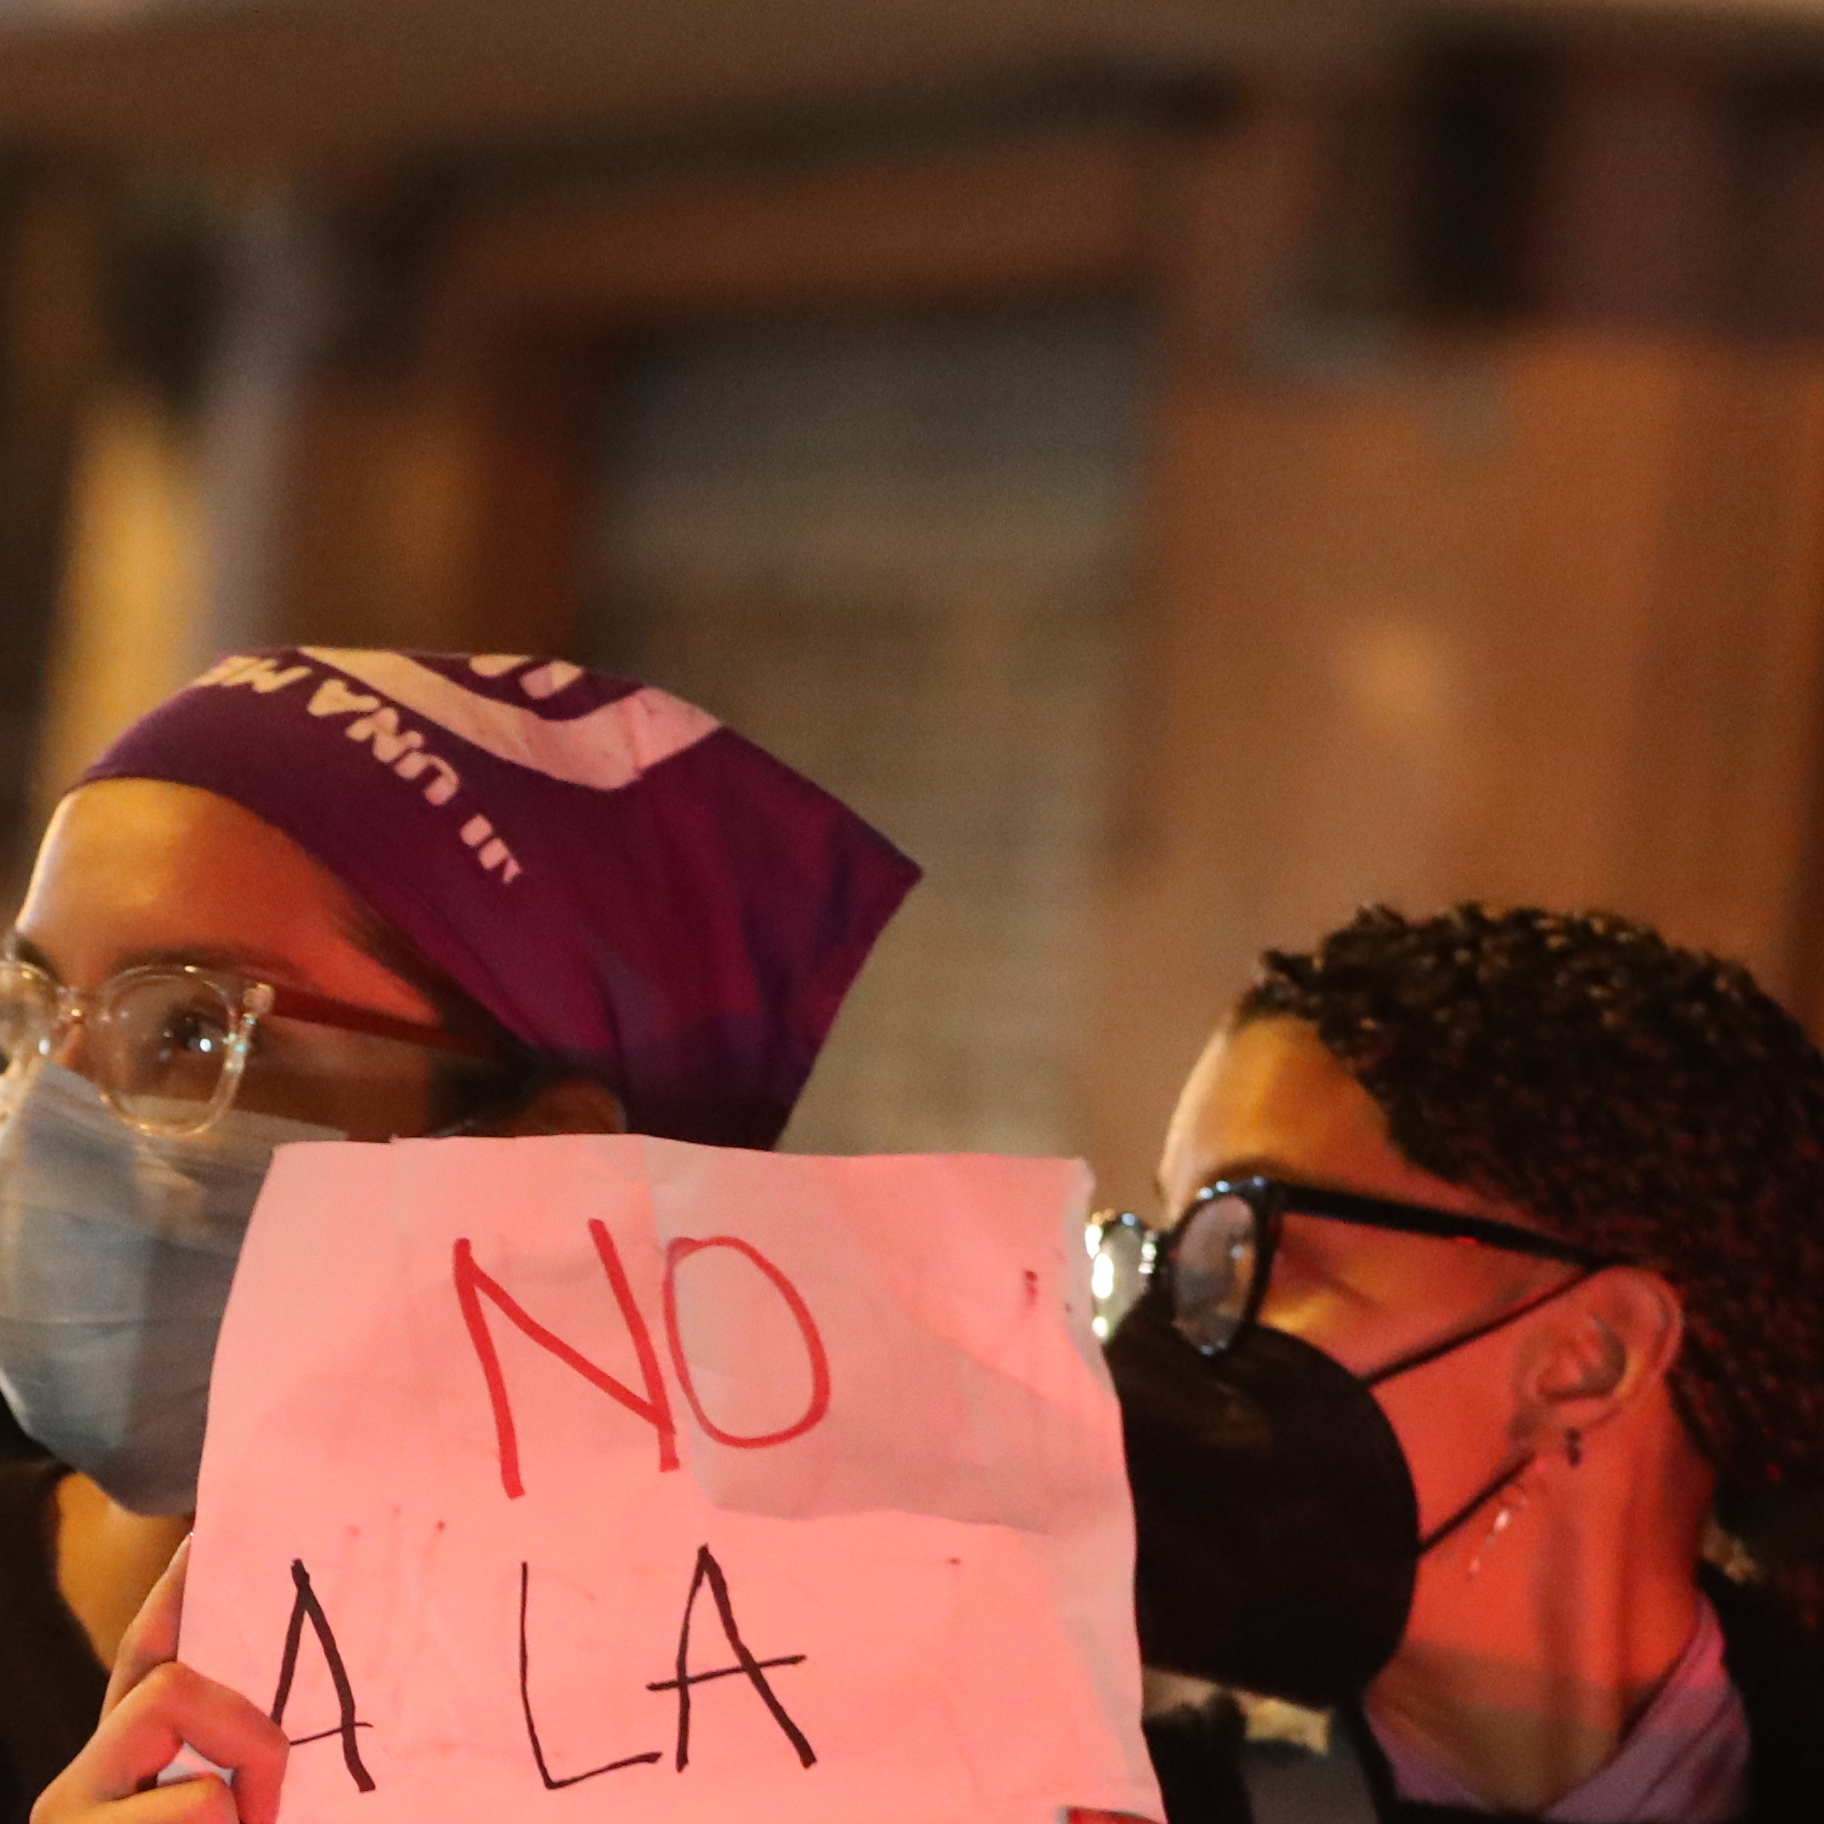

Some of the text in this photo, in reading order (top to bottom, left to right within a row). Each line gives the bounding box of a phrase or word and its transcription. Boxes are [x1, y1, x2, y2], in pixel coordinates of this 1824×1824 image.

[306, 678, 461, 807] UNA
[453, 1217, 831, 1498] NO
[517, 1543, 818, 1792] LA
